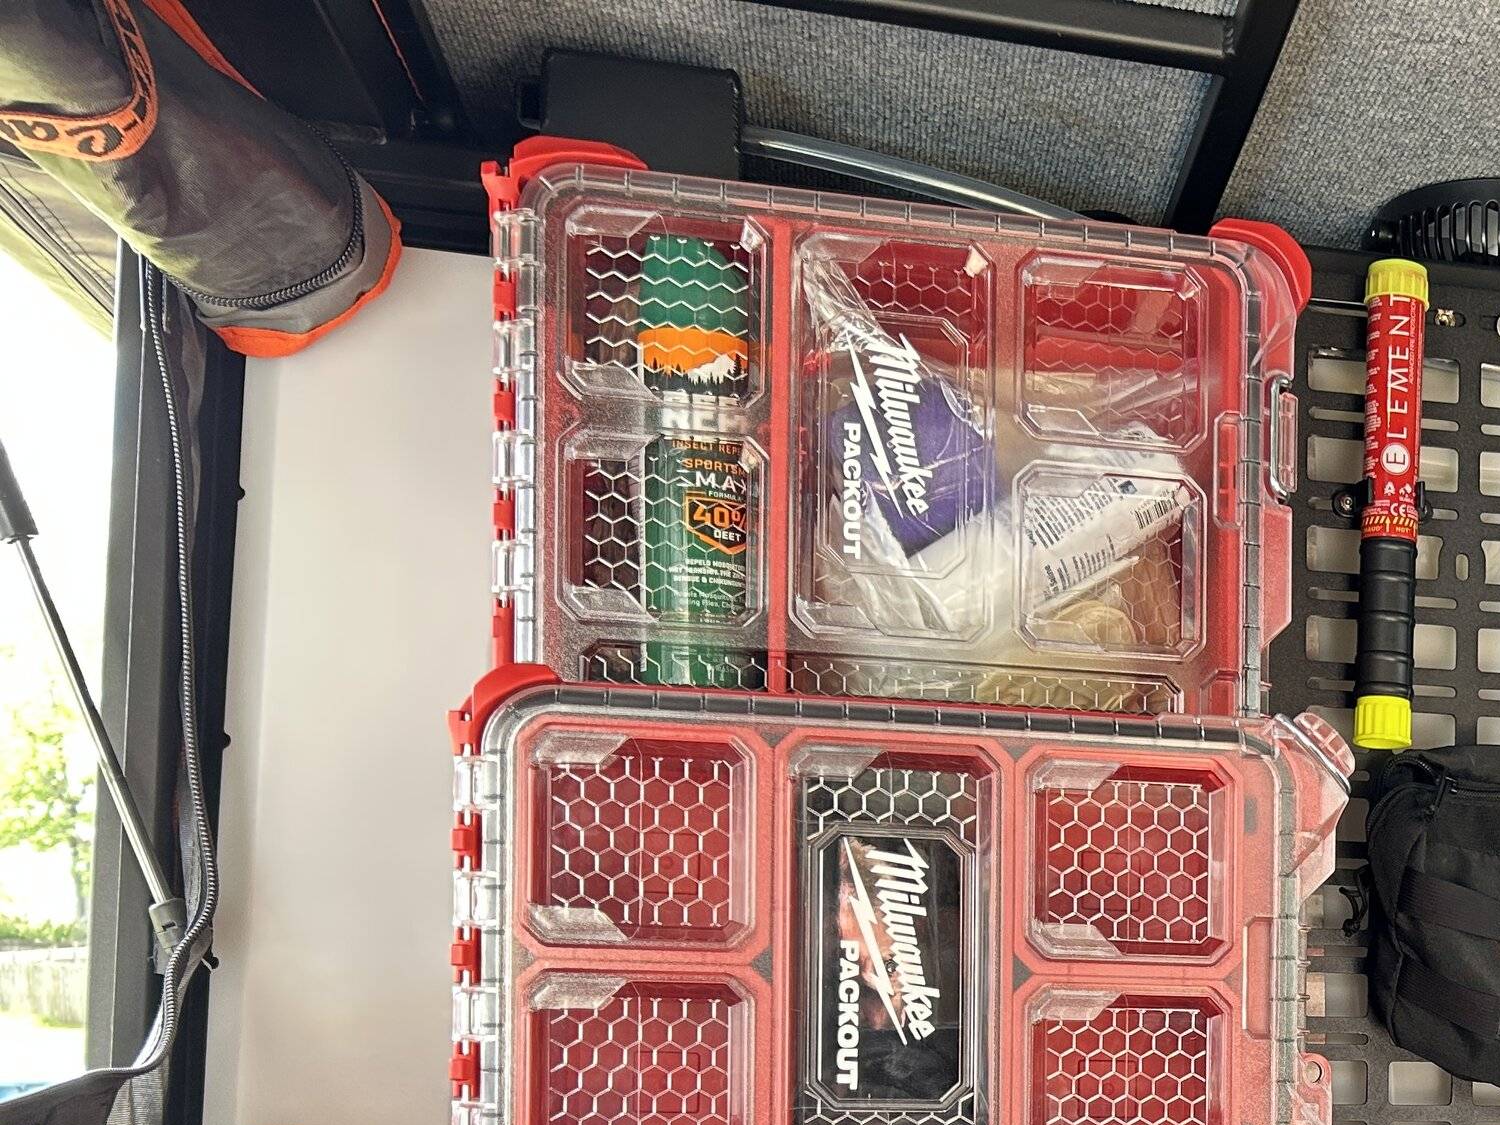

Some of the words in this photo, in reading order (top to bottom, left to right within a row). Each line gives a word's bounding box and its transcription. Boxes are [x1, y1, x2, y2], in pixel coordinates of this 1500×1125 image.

[866, 333, 933, 516] Milwaukee
[1384, 293, 1412, 469] ELEMENT
[713, 530, 741, 541] DEET
[843, 422, 861, 559] PACKOUT
[836, 939, 859, 1091] PACKOUT
[866, 838, 941, 1041] Milwaukee
